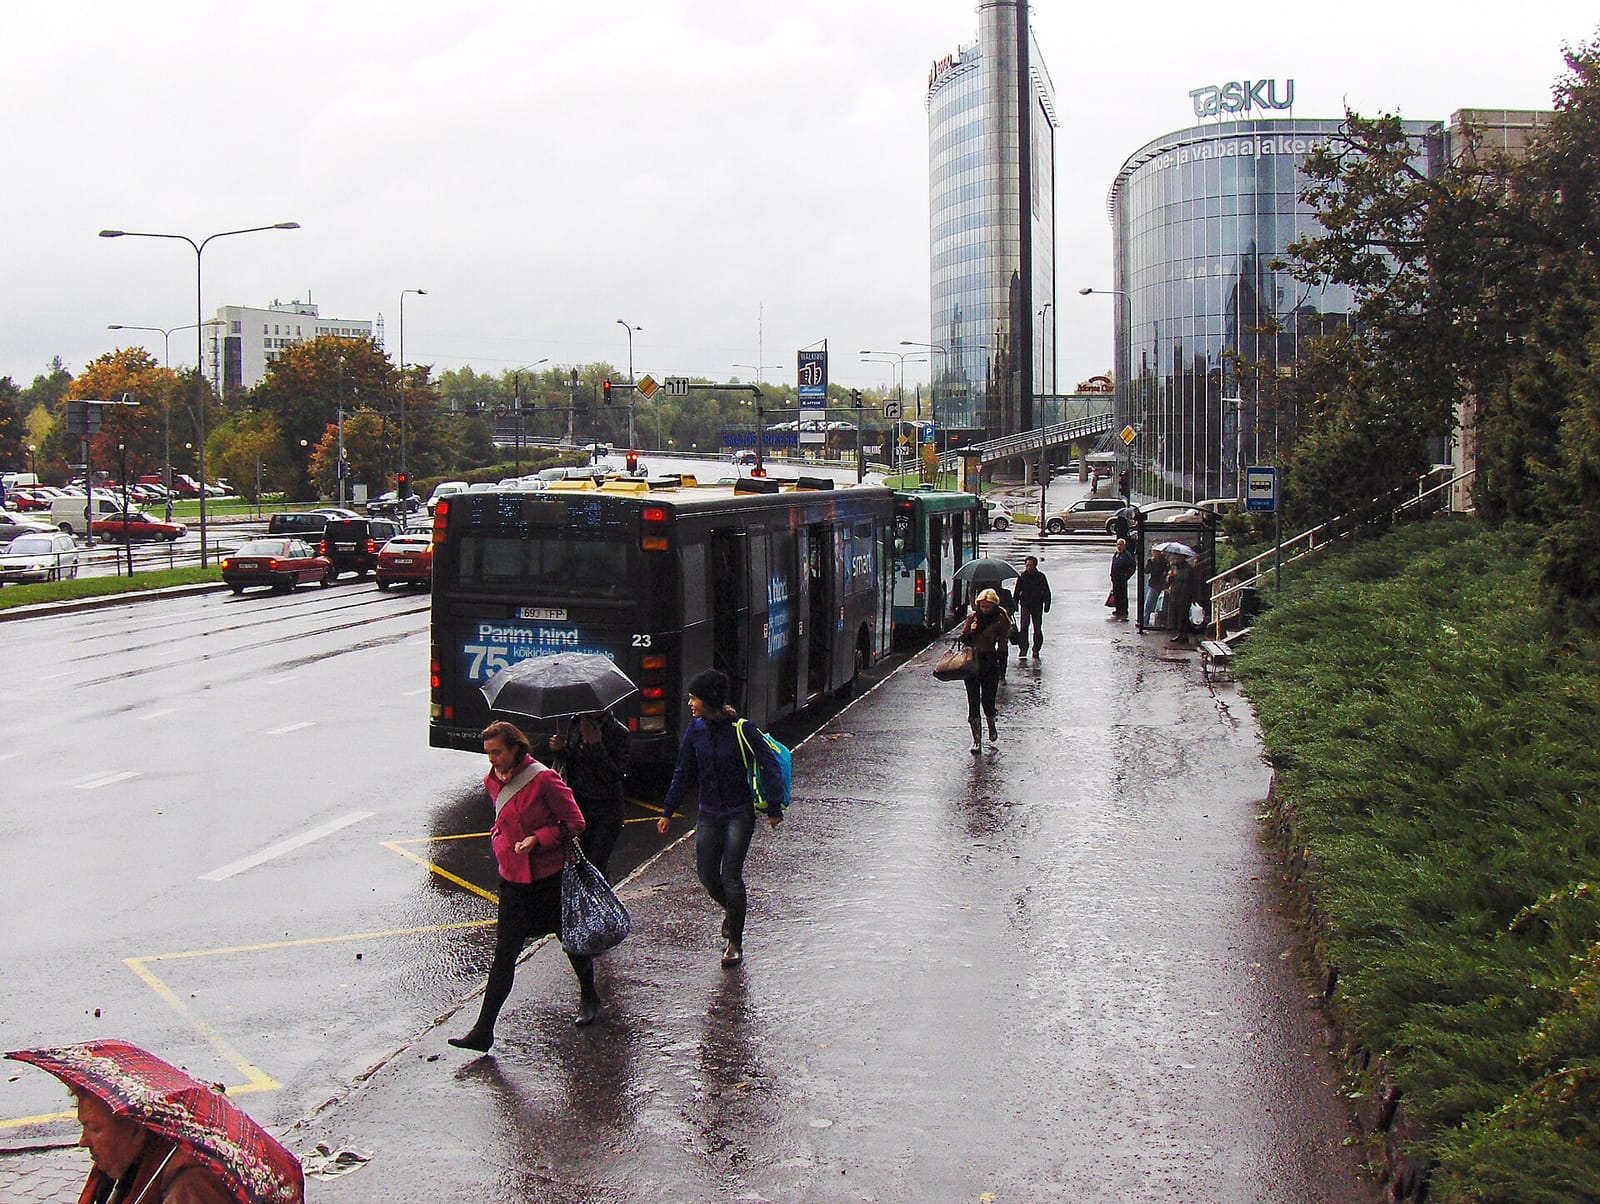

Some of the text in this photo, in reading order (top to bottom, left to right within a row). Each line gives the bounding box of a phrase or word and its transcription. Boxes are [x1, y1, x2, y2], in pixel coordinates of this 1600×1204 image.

[1176, 145, 1188, 170] ja
[926, 427, 932, 435] P
[478, 624, 579, 646] Parim hind
[631, 634, 652, 648] 23
[464, 644, 509, 680] 75
